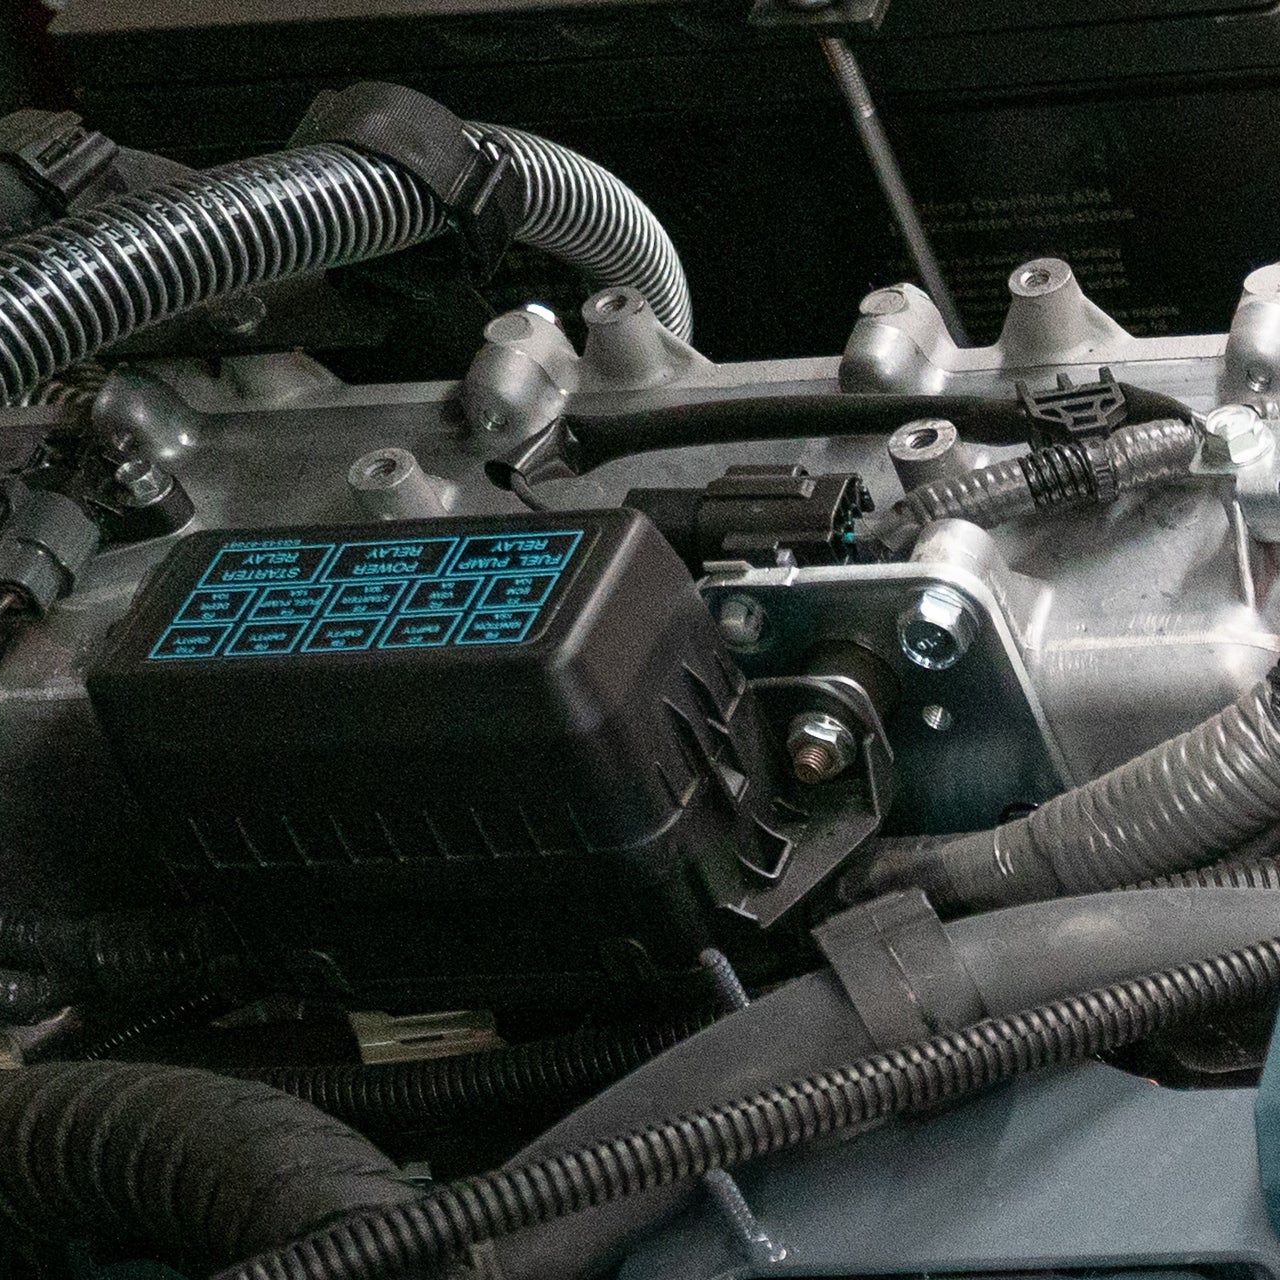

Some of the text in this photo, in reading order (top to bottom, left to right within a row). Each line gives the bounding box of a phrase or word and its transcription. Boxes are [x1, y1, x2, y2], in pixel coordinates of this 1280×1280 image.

[366, 546, 423, 558] RELAY
[491, 540, 548, 552] RELAY
[242, 552, 299, 564] RELAY
[459, 554, 562, 569] FUEL PUMP
[222, 568, 300, 580] STARTER
[353, 562, 419, 574] POWER
[326, 629, 363, 638] EMPTY
[402, 624, 441, 633] EMPTY
[173, 636, 211, 644] EMPTY
[249, 632, 287, 641] EMPTY
